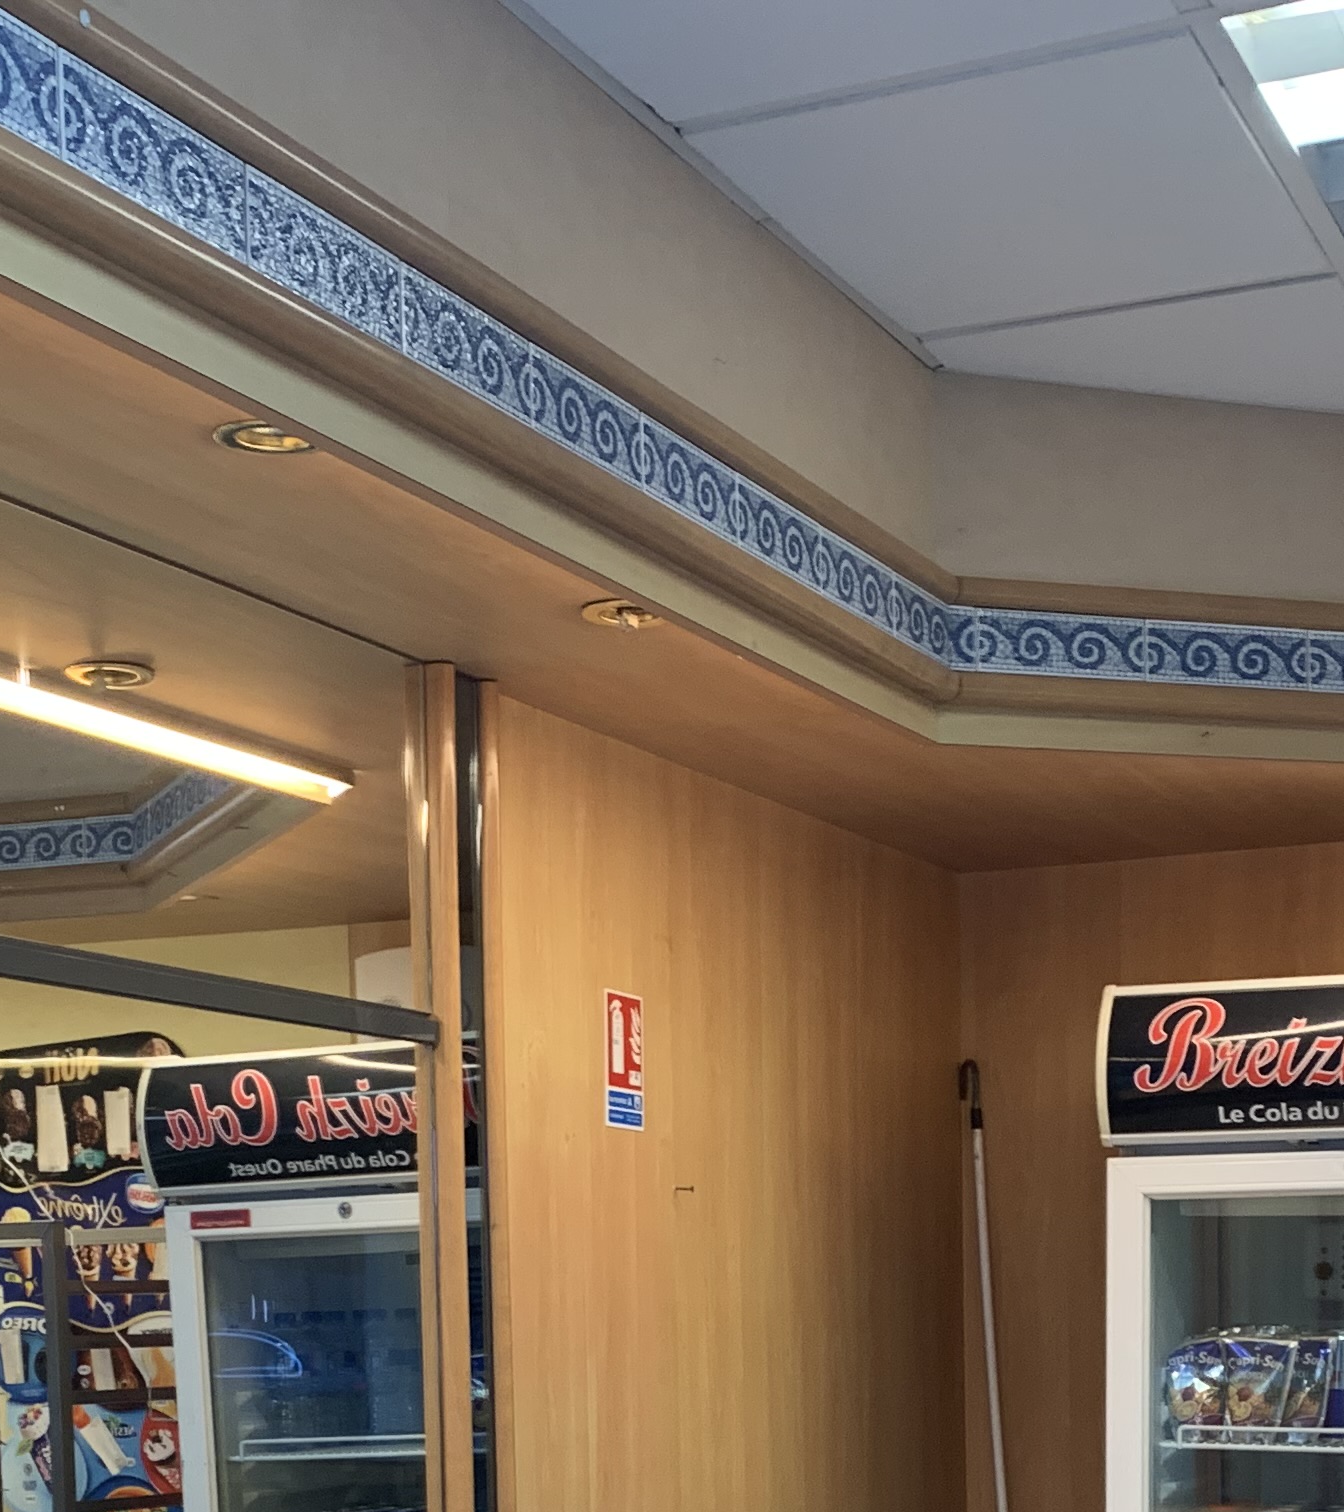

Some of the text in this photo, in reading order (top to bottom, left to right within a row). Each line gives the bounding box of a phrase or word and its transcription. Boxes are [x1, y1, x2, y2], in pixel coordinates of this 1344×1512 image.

[1218, 1105, 1245, 1125] Le
[1249, 1102, 1302, 1124] Cola
[1308, 1102, 1341, 1121] du
